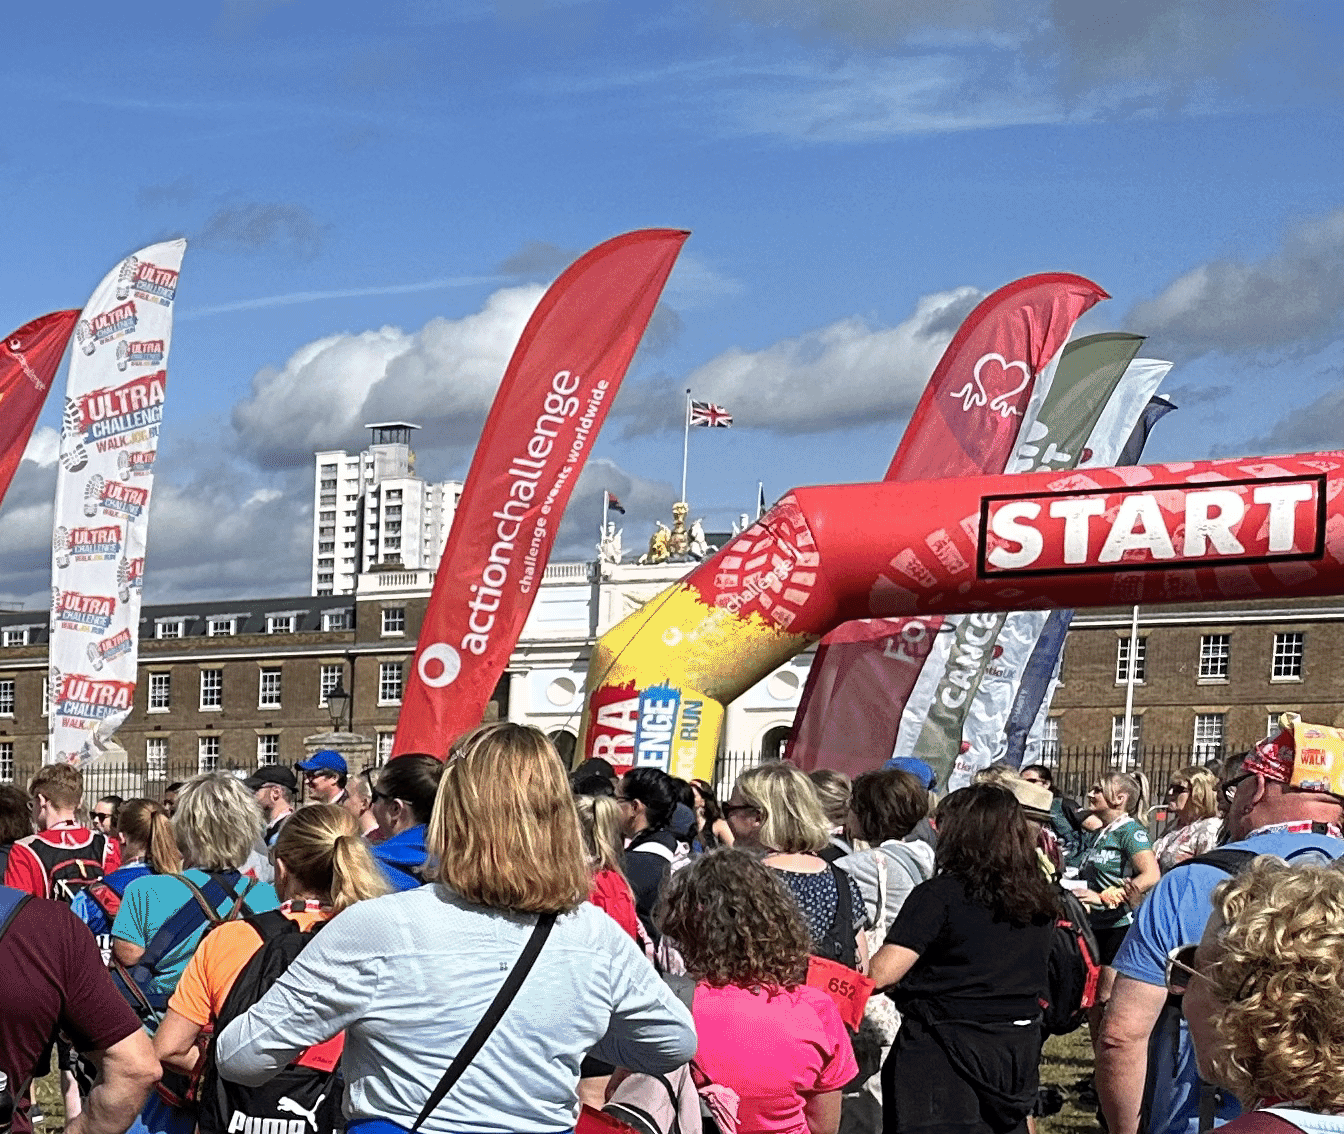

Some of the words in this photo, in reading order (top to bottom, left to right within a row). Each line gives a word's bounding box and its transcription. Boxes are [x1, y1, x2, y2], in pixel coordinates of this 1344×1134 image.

[140, 267, 177, 289] ULTRA
[96, 308, 132, 329] ULTRA
[132, 343, 161, 353] ULTRA
[88, 380, 164, 421] ULTRA
[107, 483, 143, 506] ULTRA
[520, 516, 548, 594] challenge
[540, 465, 573, 515] events
[567, 378, 610, 463] worldwide
[462, 369, 580, 655] actionchallenge
[74, 528, 117, 545] ULTRA
[988, 484, 1313, 569] START
[64, 593, 112, 615] ULTRA
[67, 679, 128, 709] ULTRA
[679, 700, 703, 741] RUN
[1301, 755, 1326, 766] WALK
